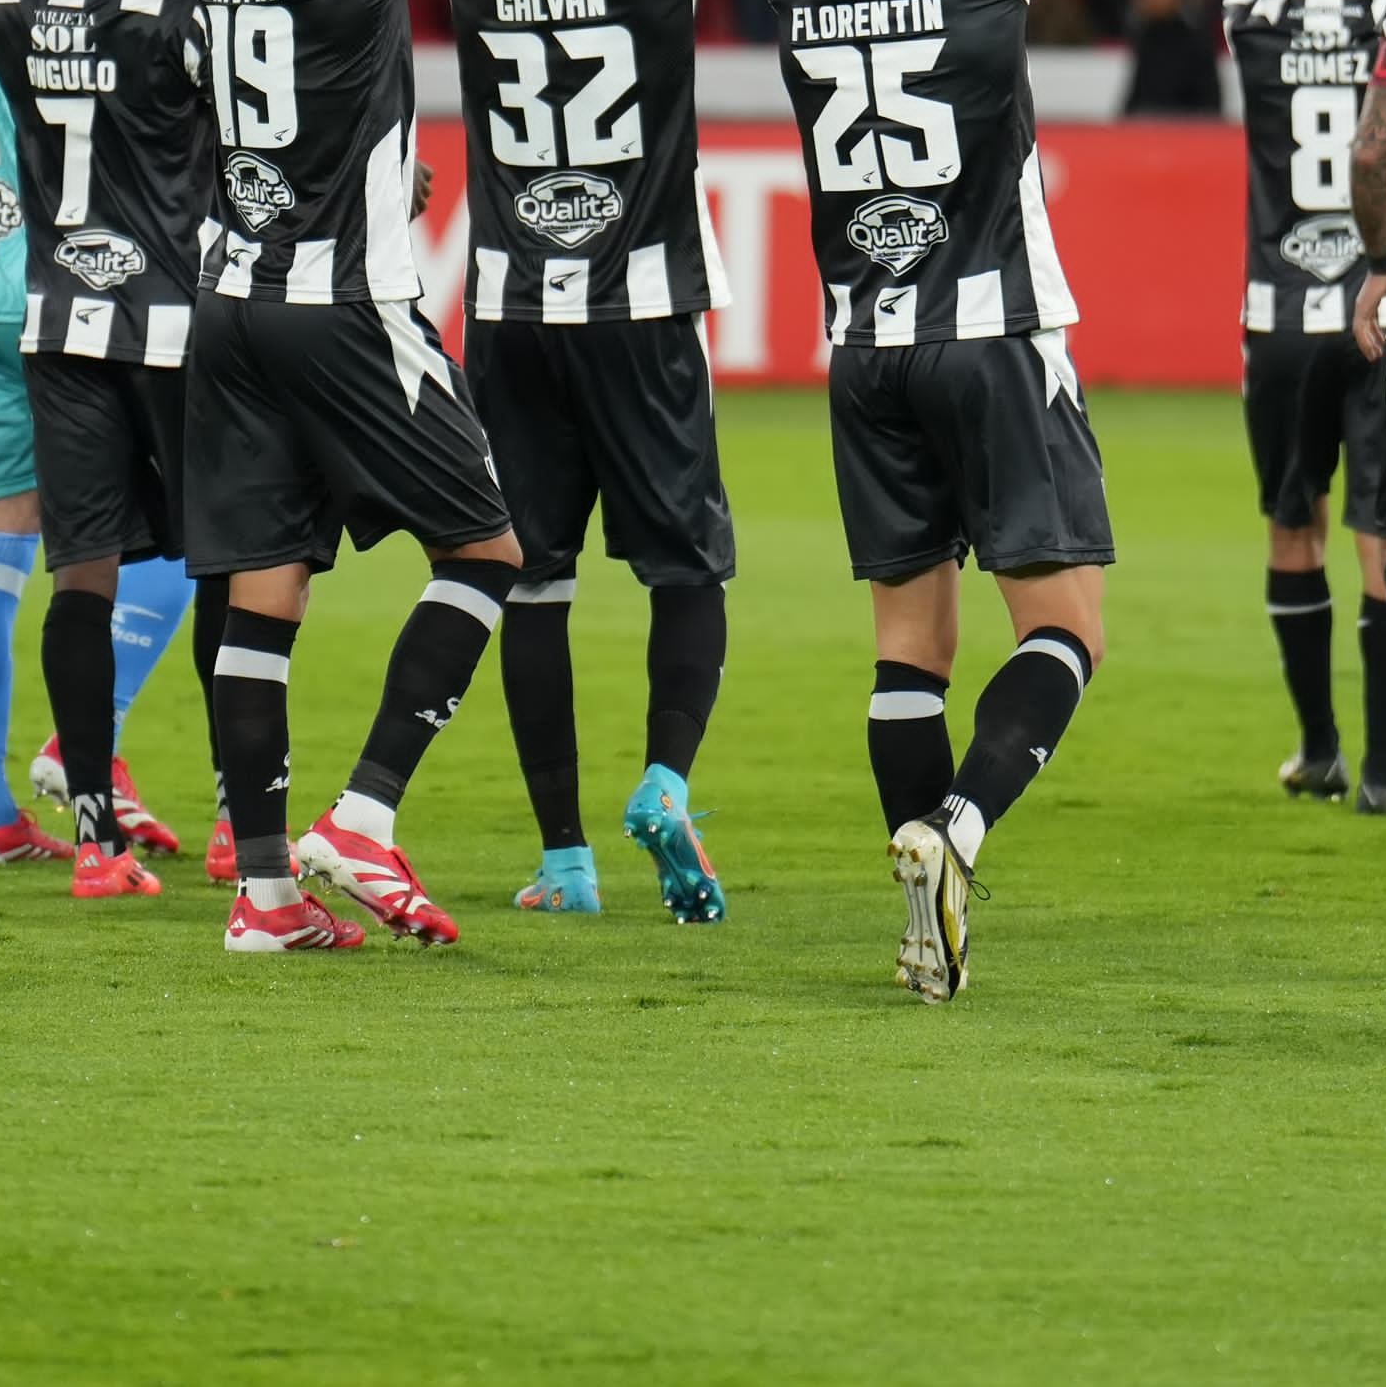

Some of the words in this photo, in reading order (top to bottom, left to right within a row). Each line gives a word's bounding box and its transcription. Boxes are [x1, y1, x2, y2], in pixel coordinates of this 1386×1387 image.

[25, 55, 116, 93] ANGULO
[30, 24, 97, 54] SOL
[33, 9, 95, 26] TARJETA
[205, 4, 299, 149] 19
[1280, 50, 1371, 85] GOMEZ
[478, 25, 644, 167] 32
[791, 38, 962, 192] 25
[1290, 86, 1358, 211] 8
[35, 97, 96, 227] 7
